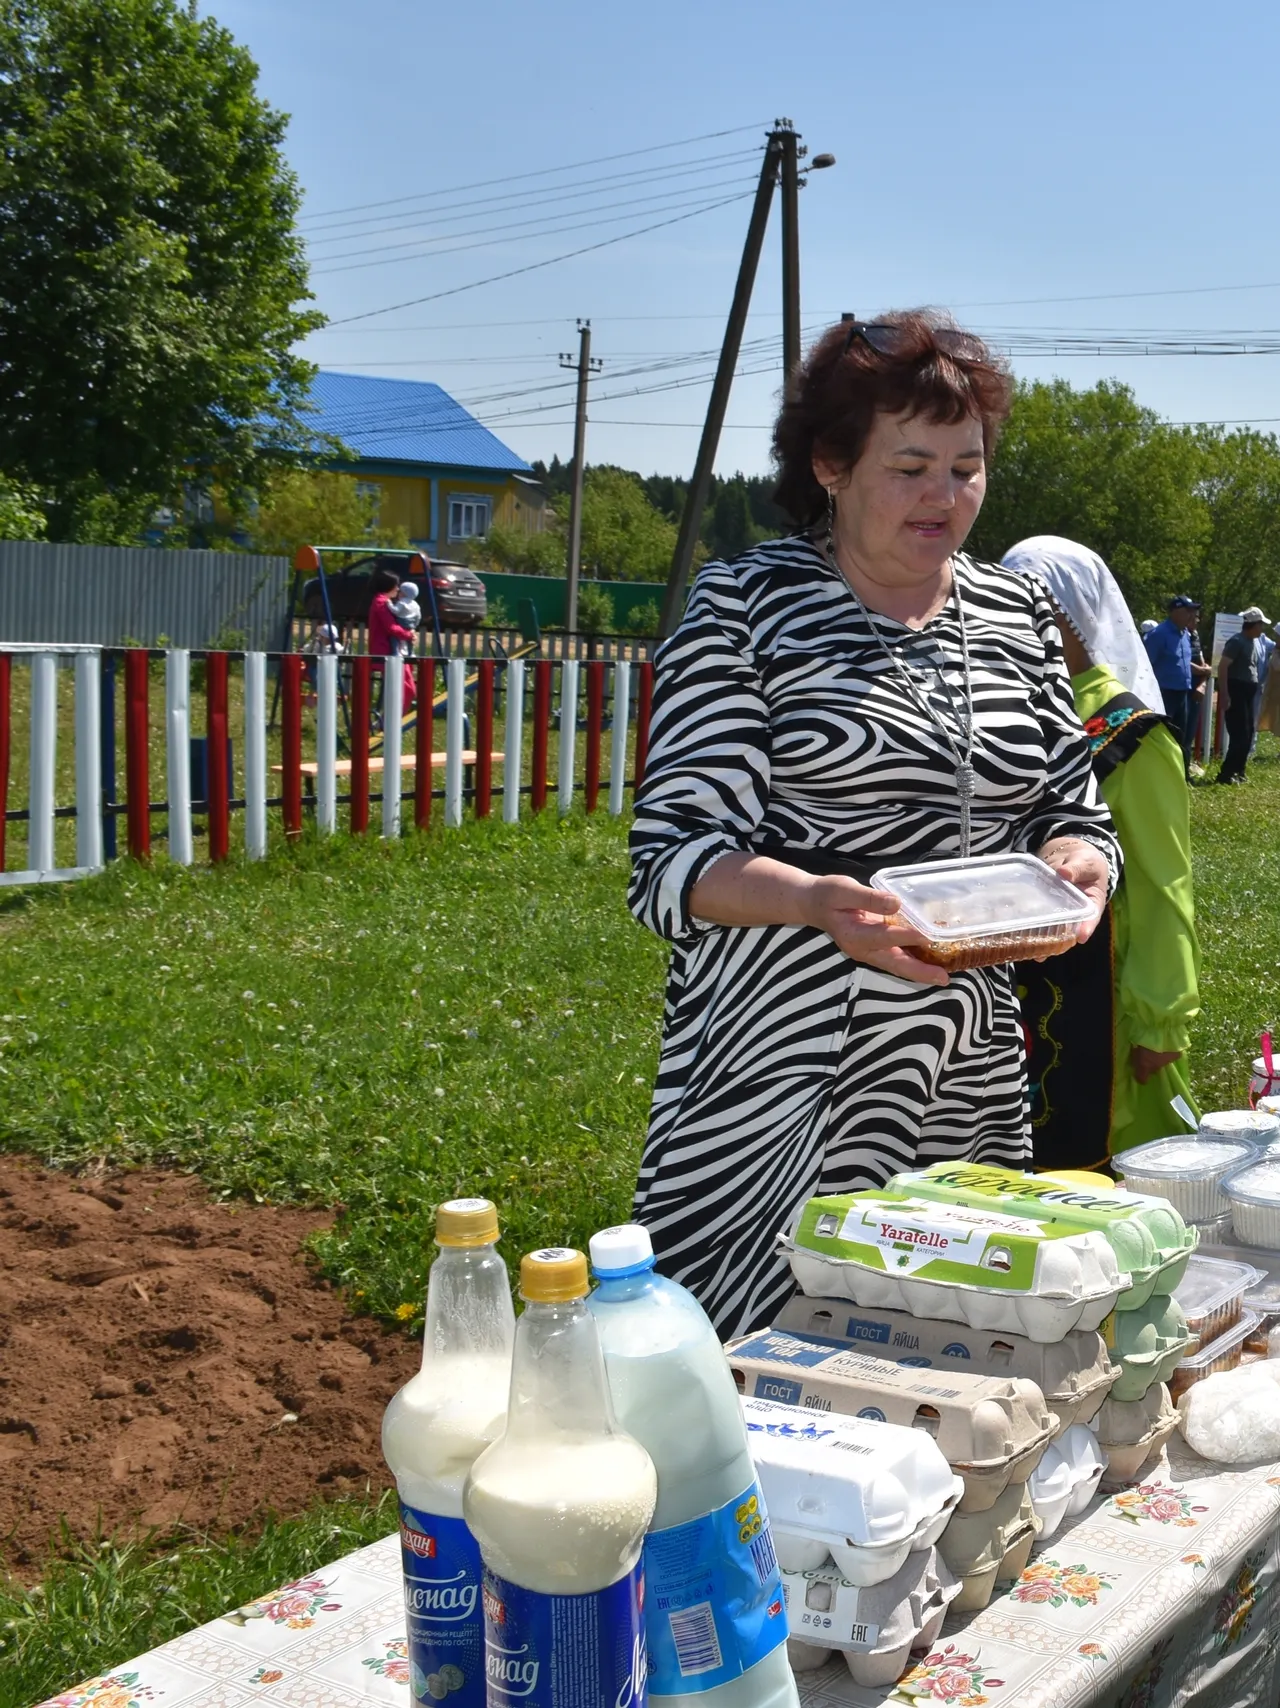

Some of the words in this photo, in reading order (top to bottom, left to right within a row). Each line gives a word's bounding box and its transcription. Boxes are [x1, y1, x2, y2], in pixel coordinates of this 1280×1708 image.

[880, 1223, 949, 1249] Yaratelle
[854, 1326, 883, 1341] ГОСТ
[892, 1332, 919, 1350] ЯЙЦА
[833, 1358, 904, 1377] КУРИНЫЕ
[763, 1383, 793, 1399] ГОСТ
[753, 1400, 829, 1419] ТРАДИЦИОННОЕ
[851, 1624, 868, 1643] EAC
